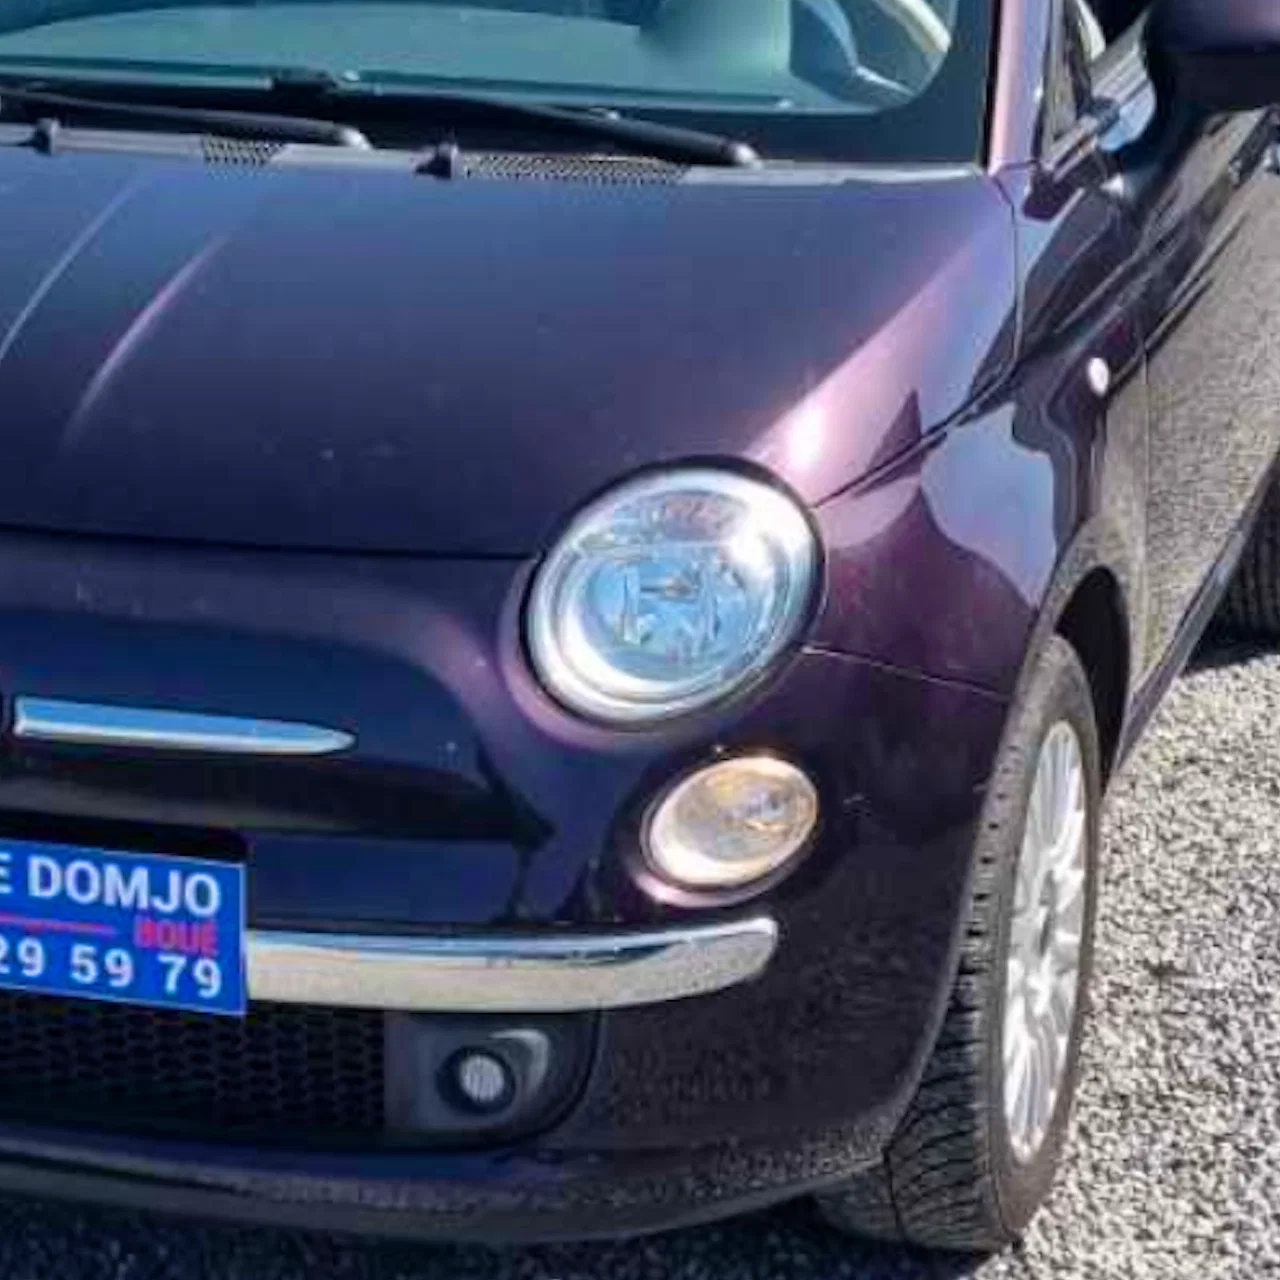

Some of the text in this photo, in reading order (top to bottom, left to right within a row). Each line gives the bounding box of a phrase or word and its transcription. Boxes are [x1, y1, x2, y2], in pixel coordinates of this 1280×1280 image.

[27, 854, 220, 917] DOMJO
[71, 943, 134, 988] 59
[158, 953, 222, 999] 79
